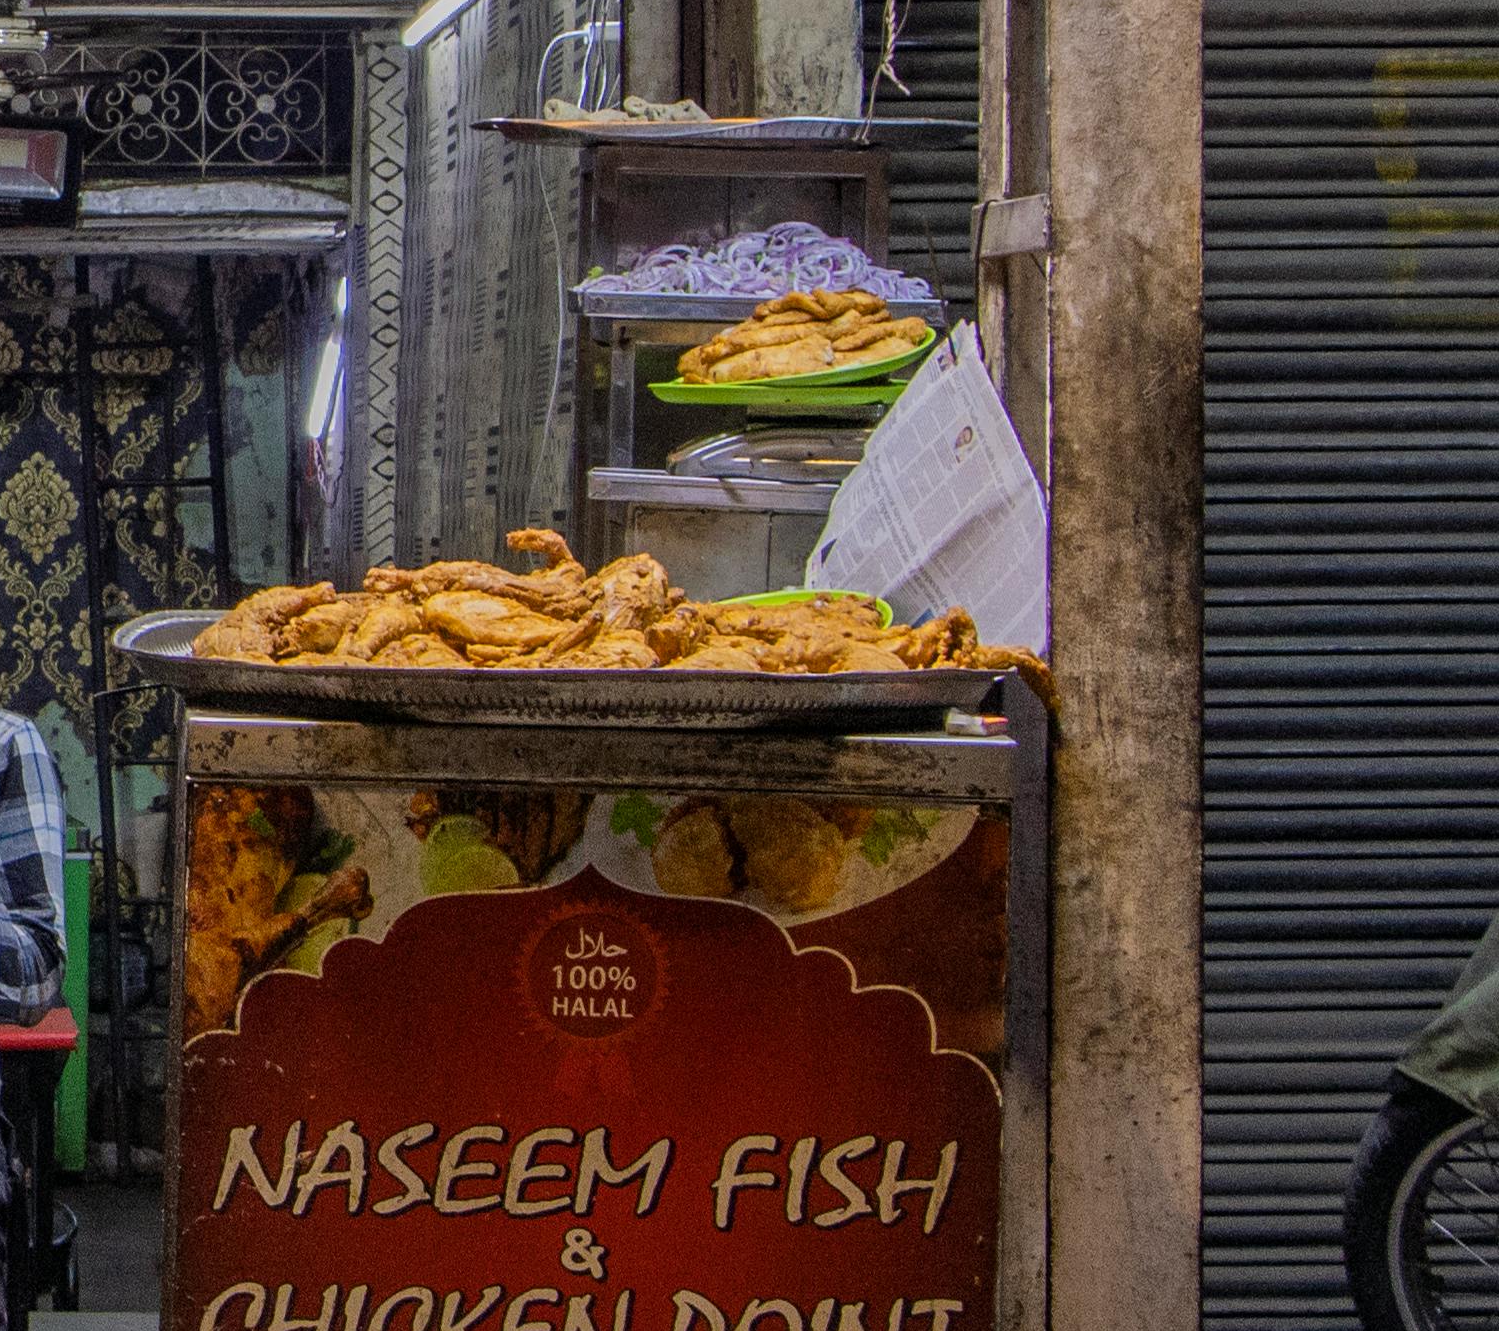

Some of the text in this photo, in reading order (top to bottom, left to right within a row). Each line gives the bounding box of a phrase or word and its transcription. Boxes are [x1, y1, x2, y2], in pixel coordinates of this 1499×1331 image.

[564, 926, 629, 959] حلال
[551, 963, 637, 993] 100%
[552, 995, 634, 1021] HALAL
[212, 1117, 959, 1235] NASEEM FISH
[560, 1227, 608, 1278] &
